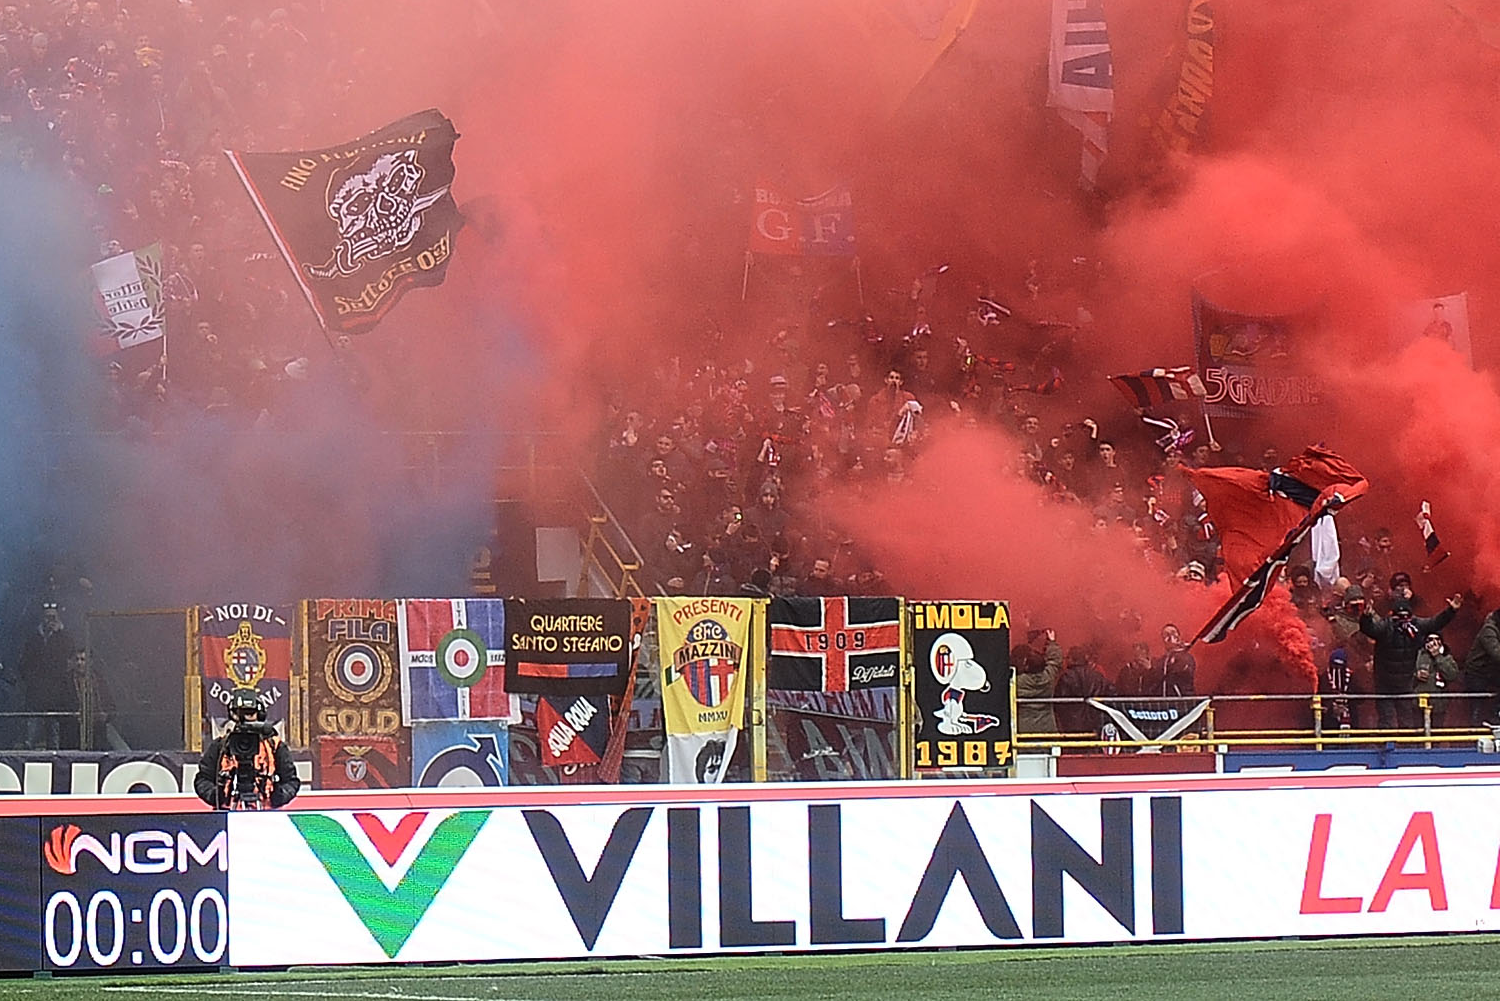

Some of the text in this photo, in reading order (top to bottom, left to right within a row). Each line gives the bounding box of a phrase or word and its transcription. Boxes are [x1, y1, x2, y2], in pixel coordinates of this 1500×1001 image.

[280, 158, 318, 192] FINO
[756, 208, 855, 244] G.F.
[216, 604, 273, 622] NOI DI
[317, 599, 399, 621] PRIMA
[673, 599, 743, 625] PRESENTI
[328, 620, 390, 642] FILA
[530, 615, 603, 633] QUARTIERE
[692, 622, 722, 640] BFC
[512, 634, 623, 653] SANTO STEFANO
[805, 632, 866, 650] 1909
[319, 708, 399, 735] GOLD
[916, 740, 1012, 766] 1987
[70, 829, 228, 874] NGM
[521, 796, 1448, 952] VILLANI LA
[44, 888, 228, 967] 00:00
